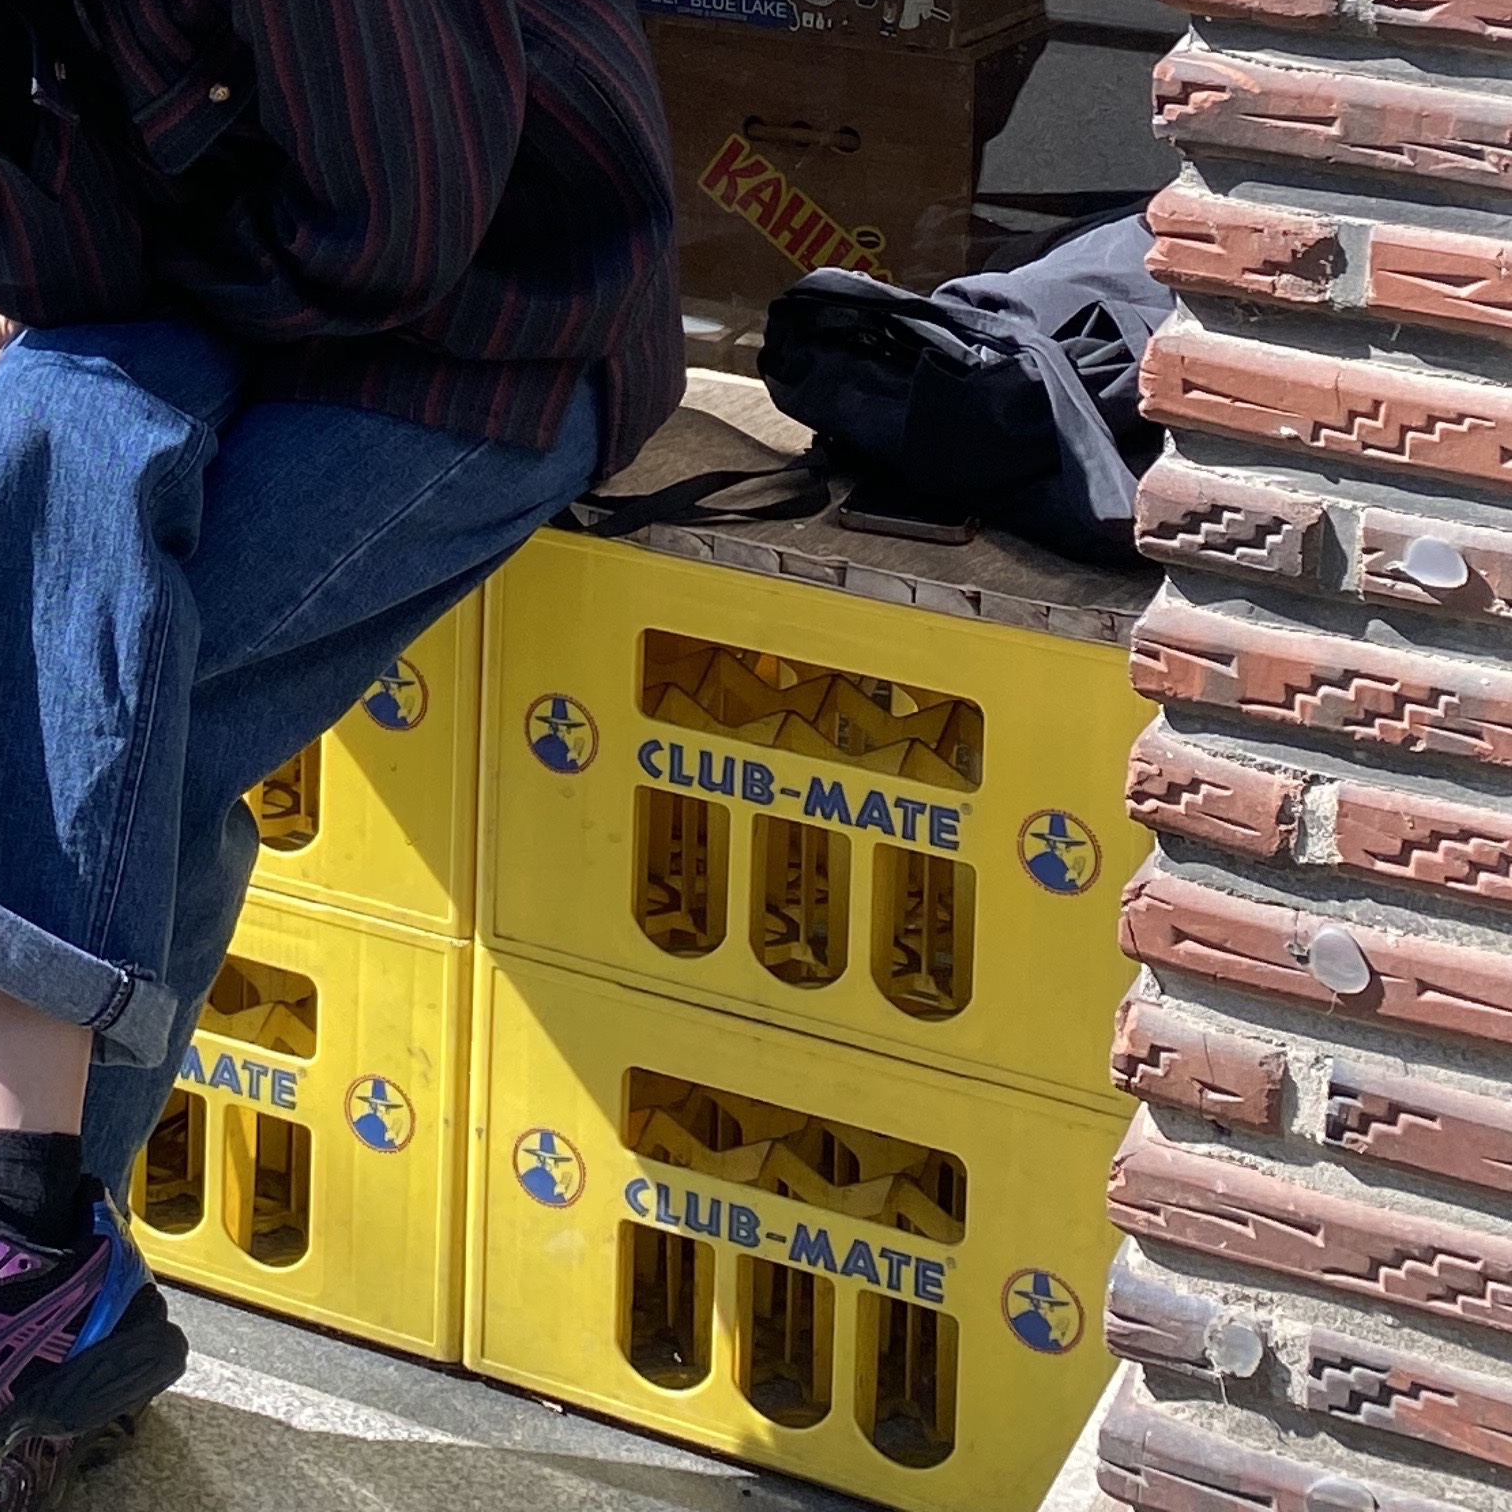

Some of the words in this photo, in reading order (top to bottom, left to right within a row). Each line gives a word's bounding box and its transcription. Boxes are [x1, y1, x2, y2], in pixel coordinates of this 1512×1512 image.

[701, 136, 890, 285] KAHL
[638, 738, 961, 851] CLUB-MATE
[624, 1177, 946, 1305] CLUB-MATE
